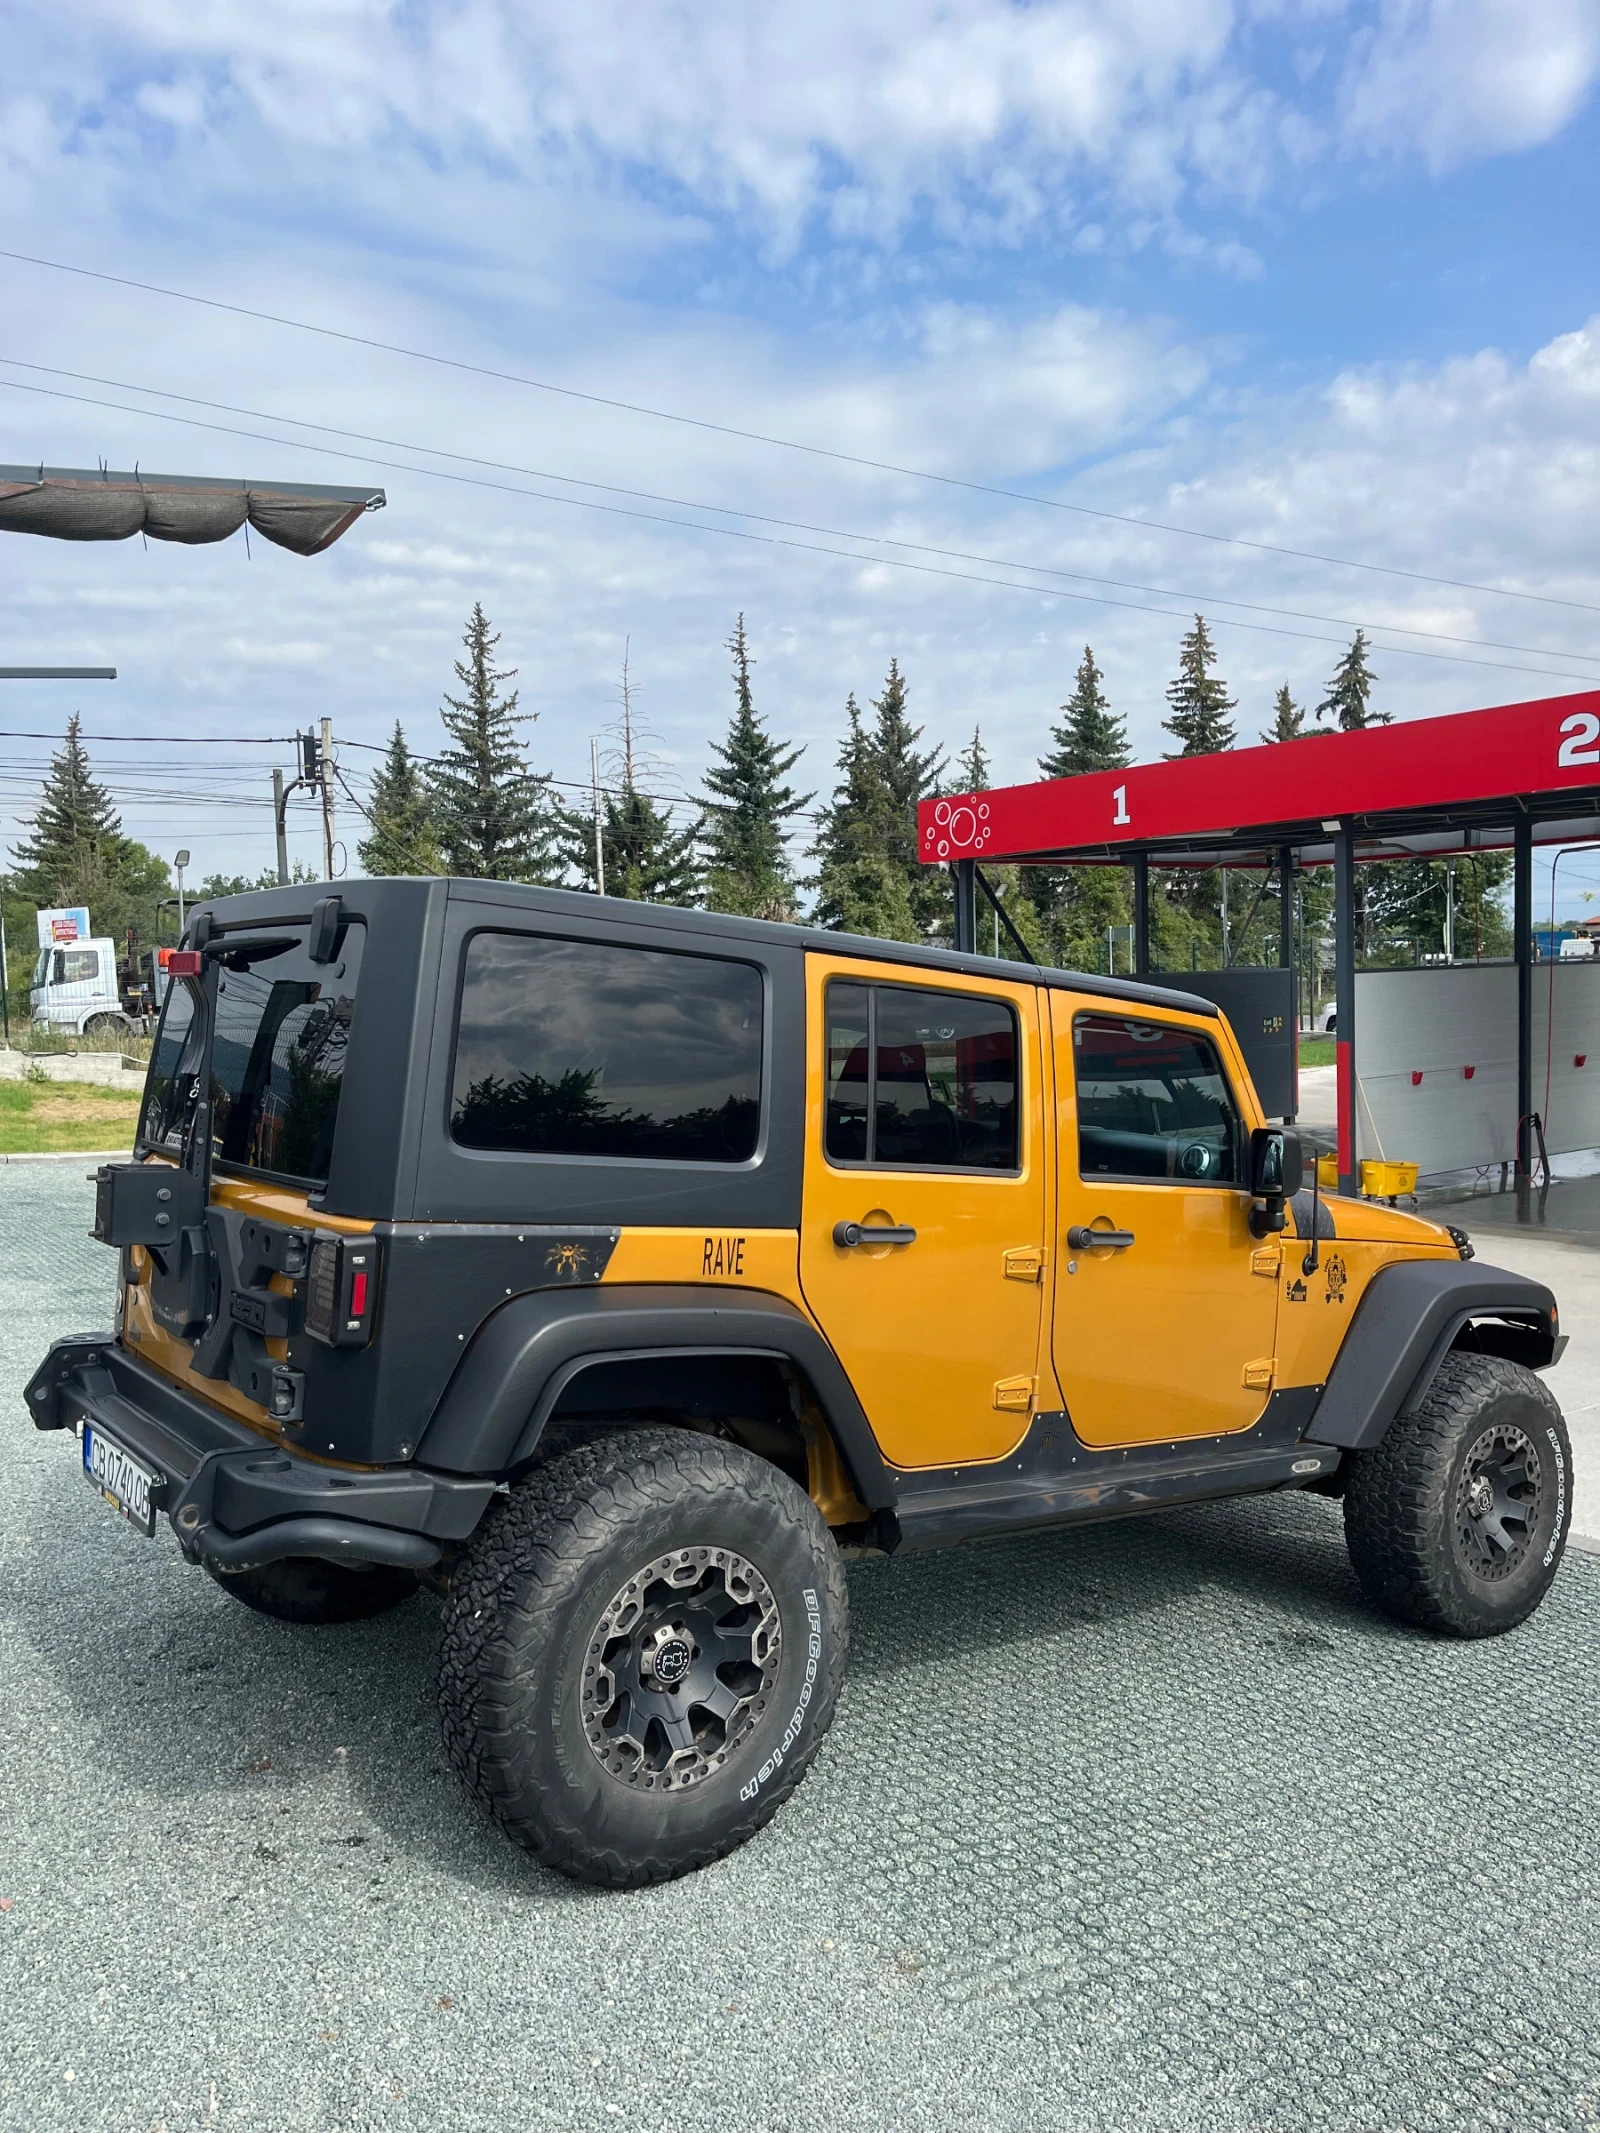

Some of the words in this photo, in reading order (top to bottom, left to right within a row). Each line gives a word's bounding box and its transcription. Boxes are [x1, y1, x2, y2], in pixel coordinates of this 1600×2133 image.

[1557, 711, 1600, 769] 2
[1113, 784, 1131, 826] 1
[702, 1237, 746, 1276] RAVE
[92, 1438, 106, 1480] CB
[108, 1450, 134, 1505] 0740
[740, 1588, 822, 1802] BFGoodrich
